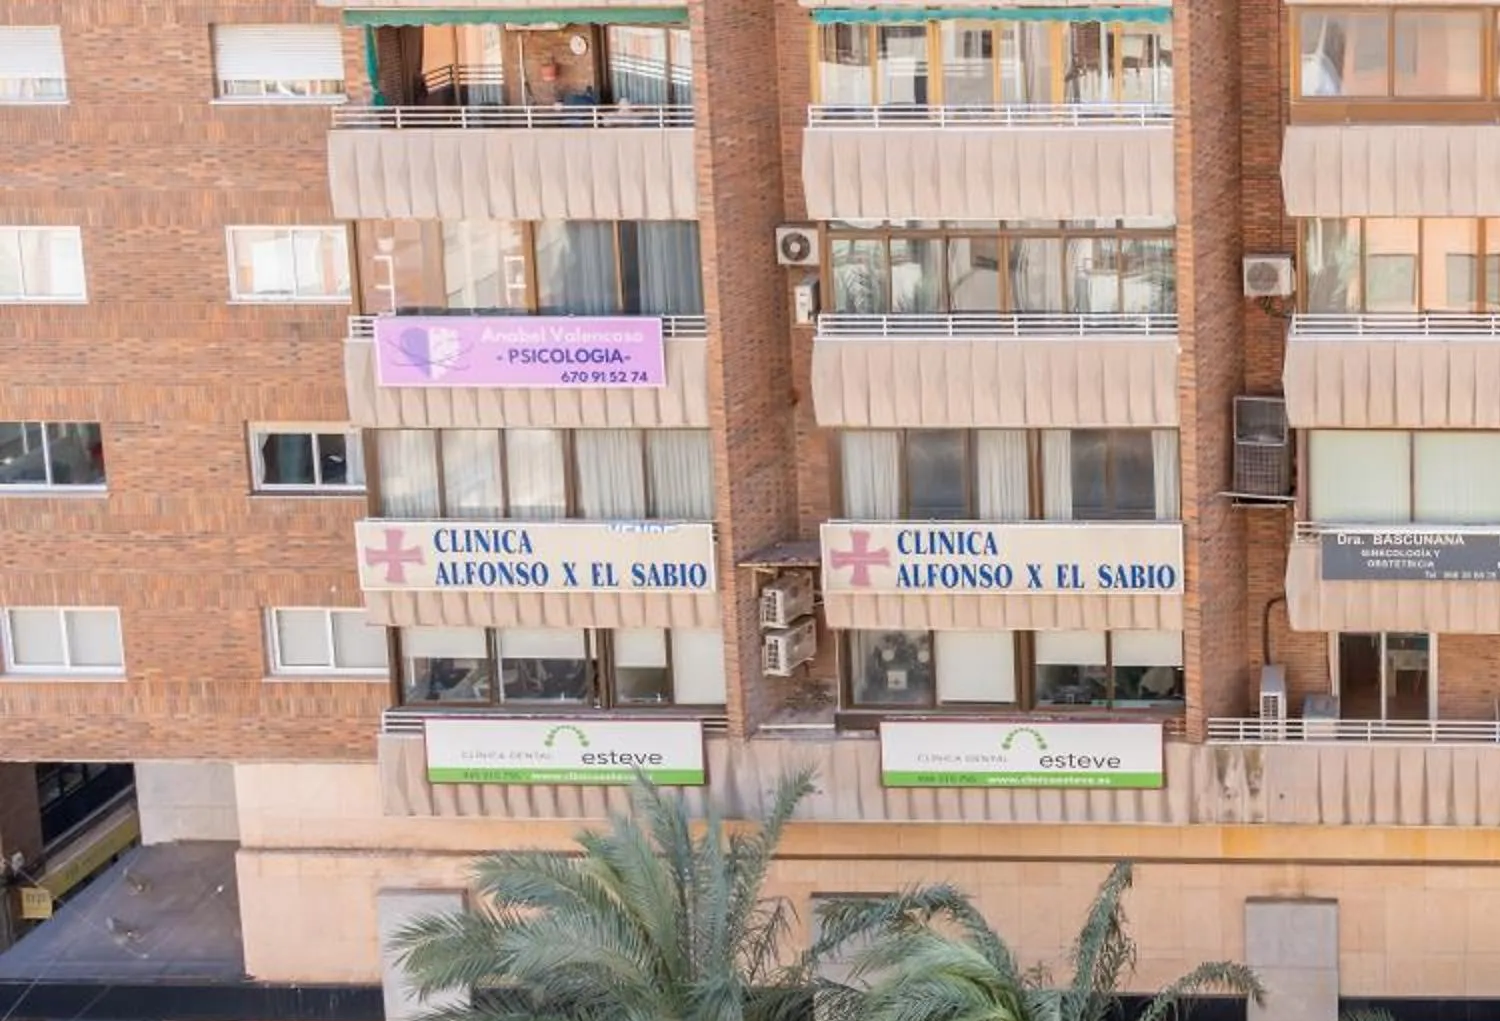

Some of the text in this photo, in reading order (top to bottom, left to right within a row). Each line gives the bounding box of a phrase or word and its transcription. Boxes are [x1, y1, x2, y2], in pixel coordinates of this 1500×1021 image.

[480, 326, 547, 343] Anabel
[561, 371, 589, 383] 670
[631, 371, 648, 383] 74
[433, 528, 533, 554] CLINICA
[896, 530, 999, 556] CLINICA
[434, 561, 707, 588] ALFONSO X EL SABIO
[896, 563, 1176, 589] ALFONSO X EL SABIO
[581, 751, 664, 766] esteve
[1039, 752, 1121, 769] esteve
